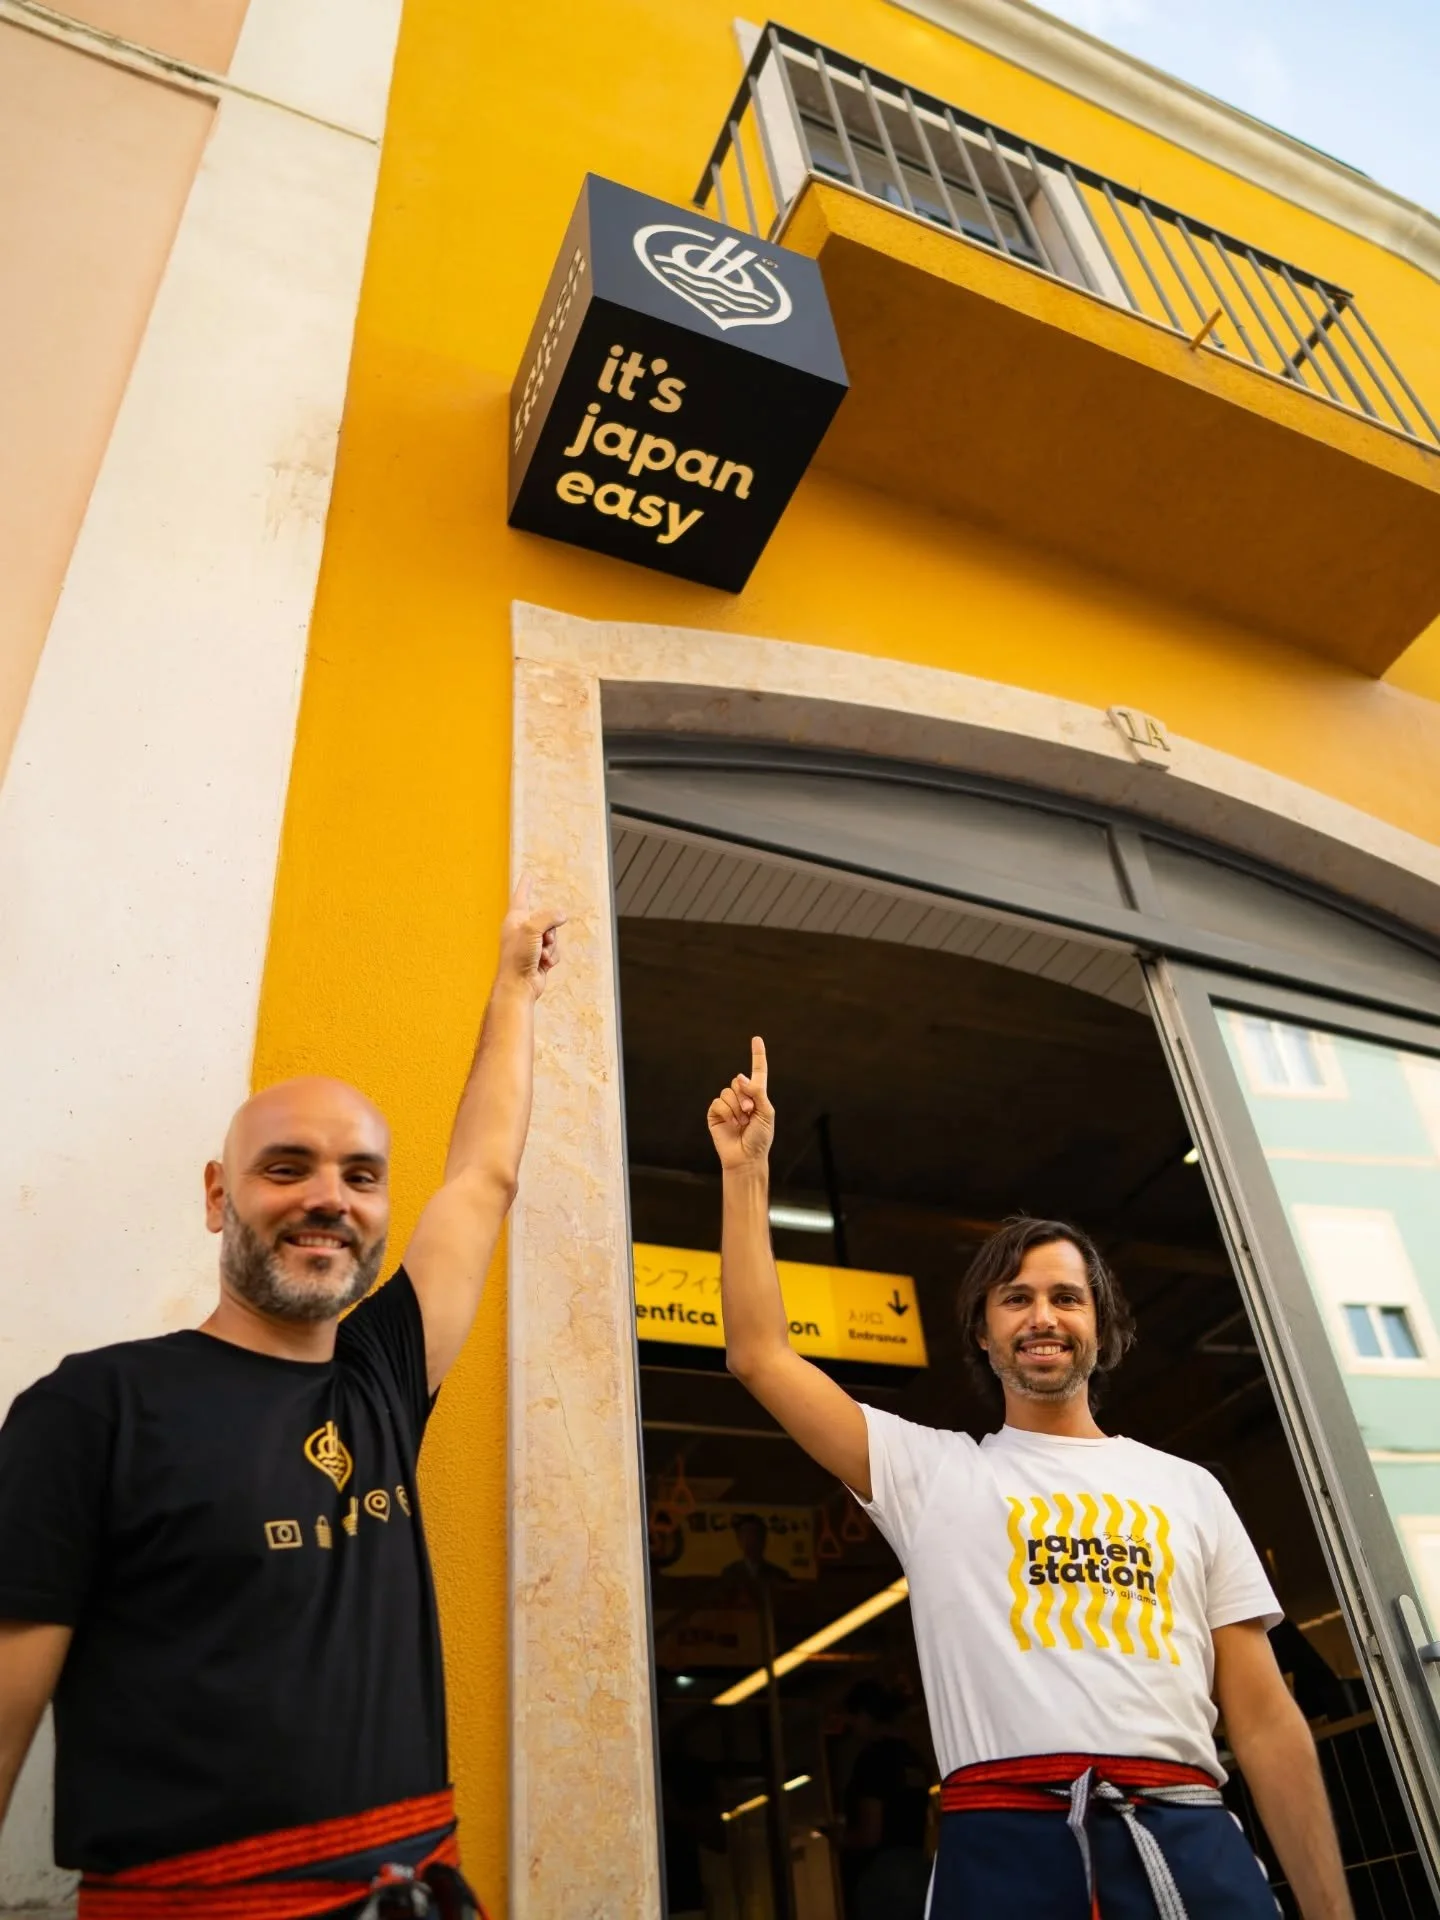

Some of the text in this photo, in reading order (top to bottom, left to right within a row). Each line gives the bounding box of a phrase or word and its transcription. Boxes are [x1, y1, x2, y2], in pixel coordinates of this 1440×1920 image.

[598, 344, 687, 414] it's
[564, 403, 754, 500] japan
[556, 470, 704, 545] easy
[636, 1302, 718, 1326] enfica
[848, 1328, 908, 1344] Entrance
[1027, 1534, 1152, 1567] ramen
[1028, 1556, 1156, 1594] station
[1102, 1586, 1115, 1597] by
